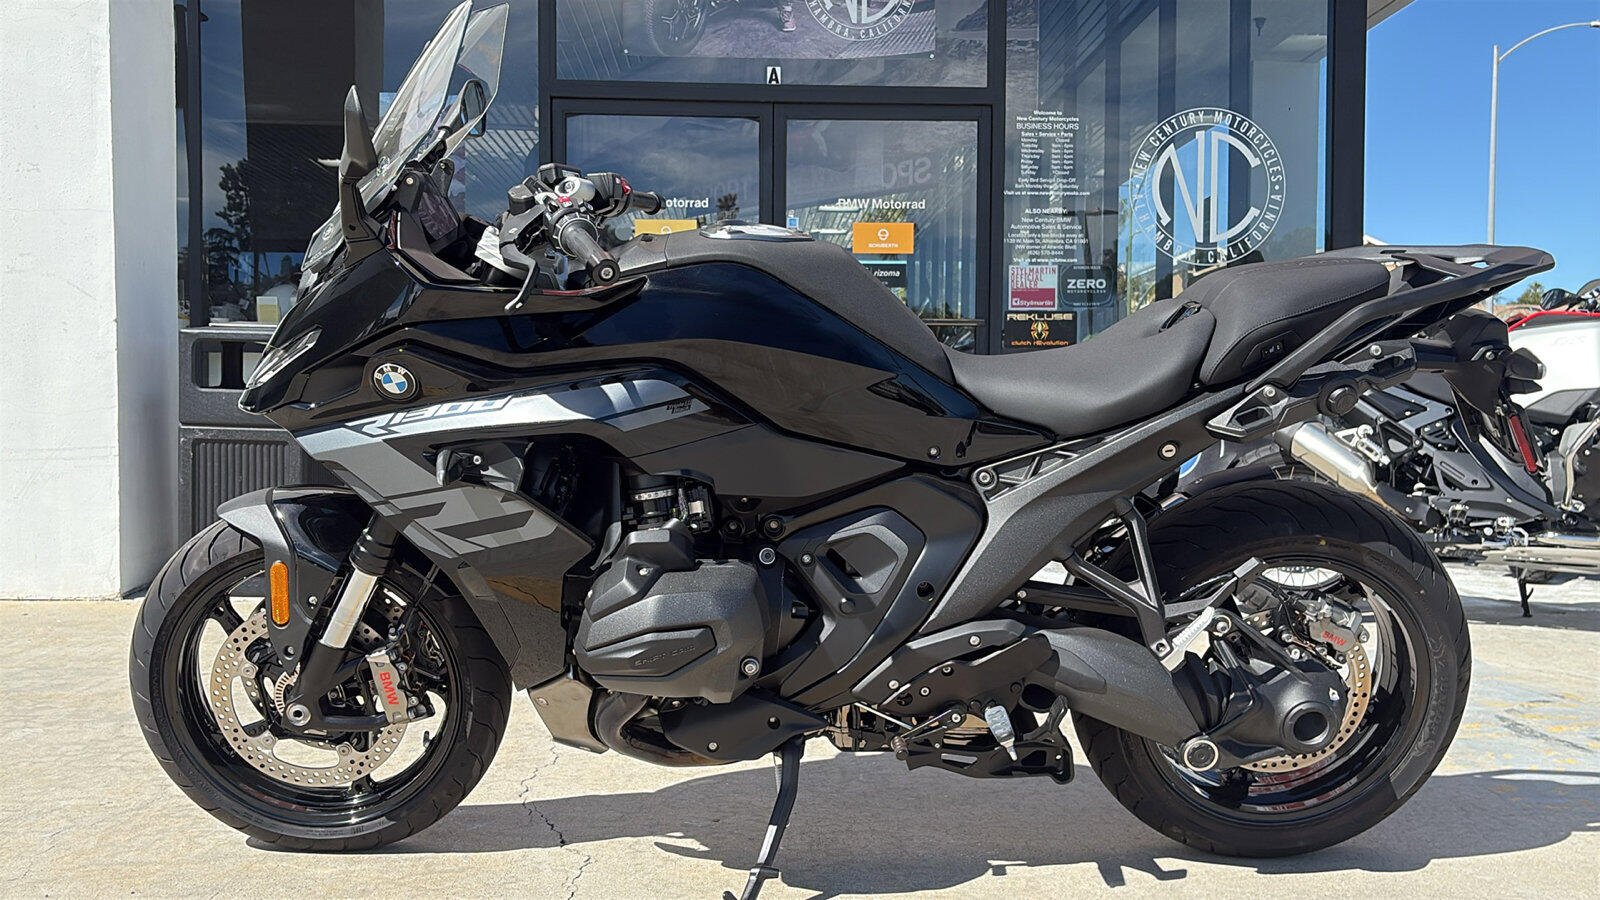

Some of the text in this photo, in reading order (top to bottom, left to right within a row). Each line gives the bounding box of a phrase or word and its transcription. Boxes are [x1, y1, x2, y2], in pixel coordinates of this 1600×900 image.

[768, 67, 780, 84] A
[1016, 122, 1080, 130] BUSINESS HOURS
[1134, 110, 1282, 183] NEW CENTURY MOTORCYCLES
[665, 197, 709, 208] otorrad
[837, 198, 926, 209] BMW Motorrad
[1207, 194, 1282, 263] CALIFORNIA
[873, 269, 901, 277] rizoma
[1011, 266, 1057, 275] STYLMARTIN
[1011, 280, 1039, 289] DEALER
[1066, 279, 1107, 289] ZERO
[1019, 299, 1054, 307] Stylmartin
[1006, 313, 1073, 321] REKLUSE
[344, 395, 513, 436] R1300
[1321, 630, 1347, 646] BMW
[379, 671, 399, 705] BMW
